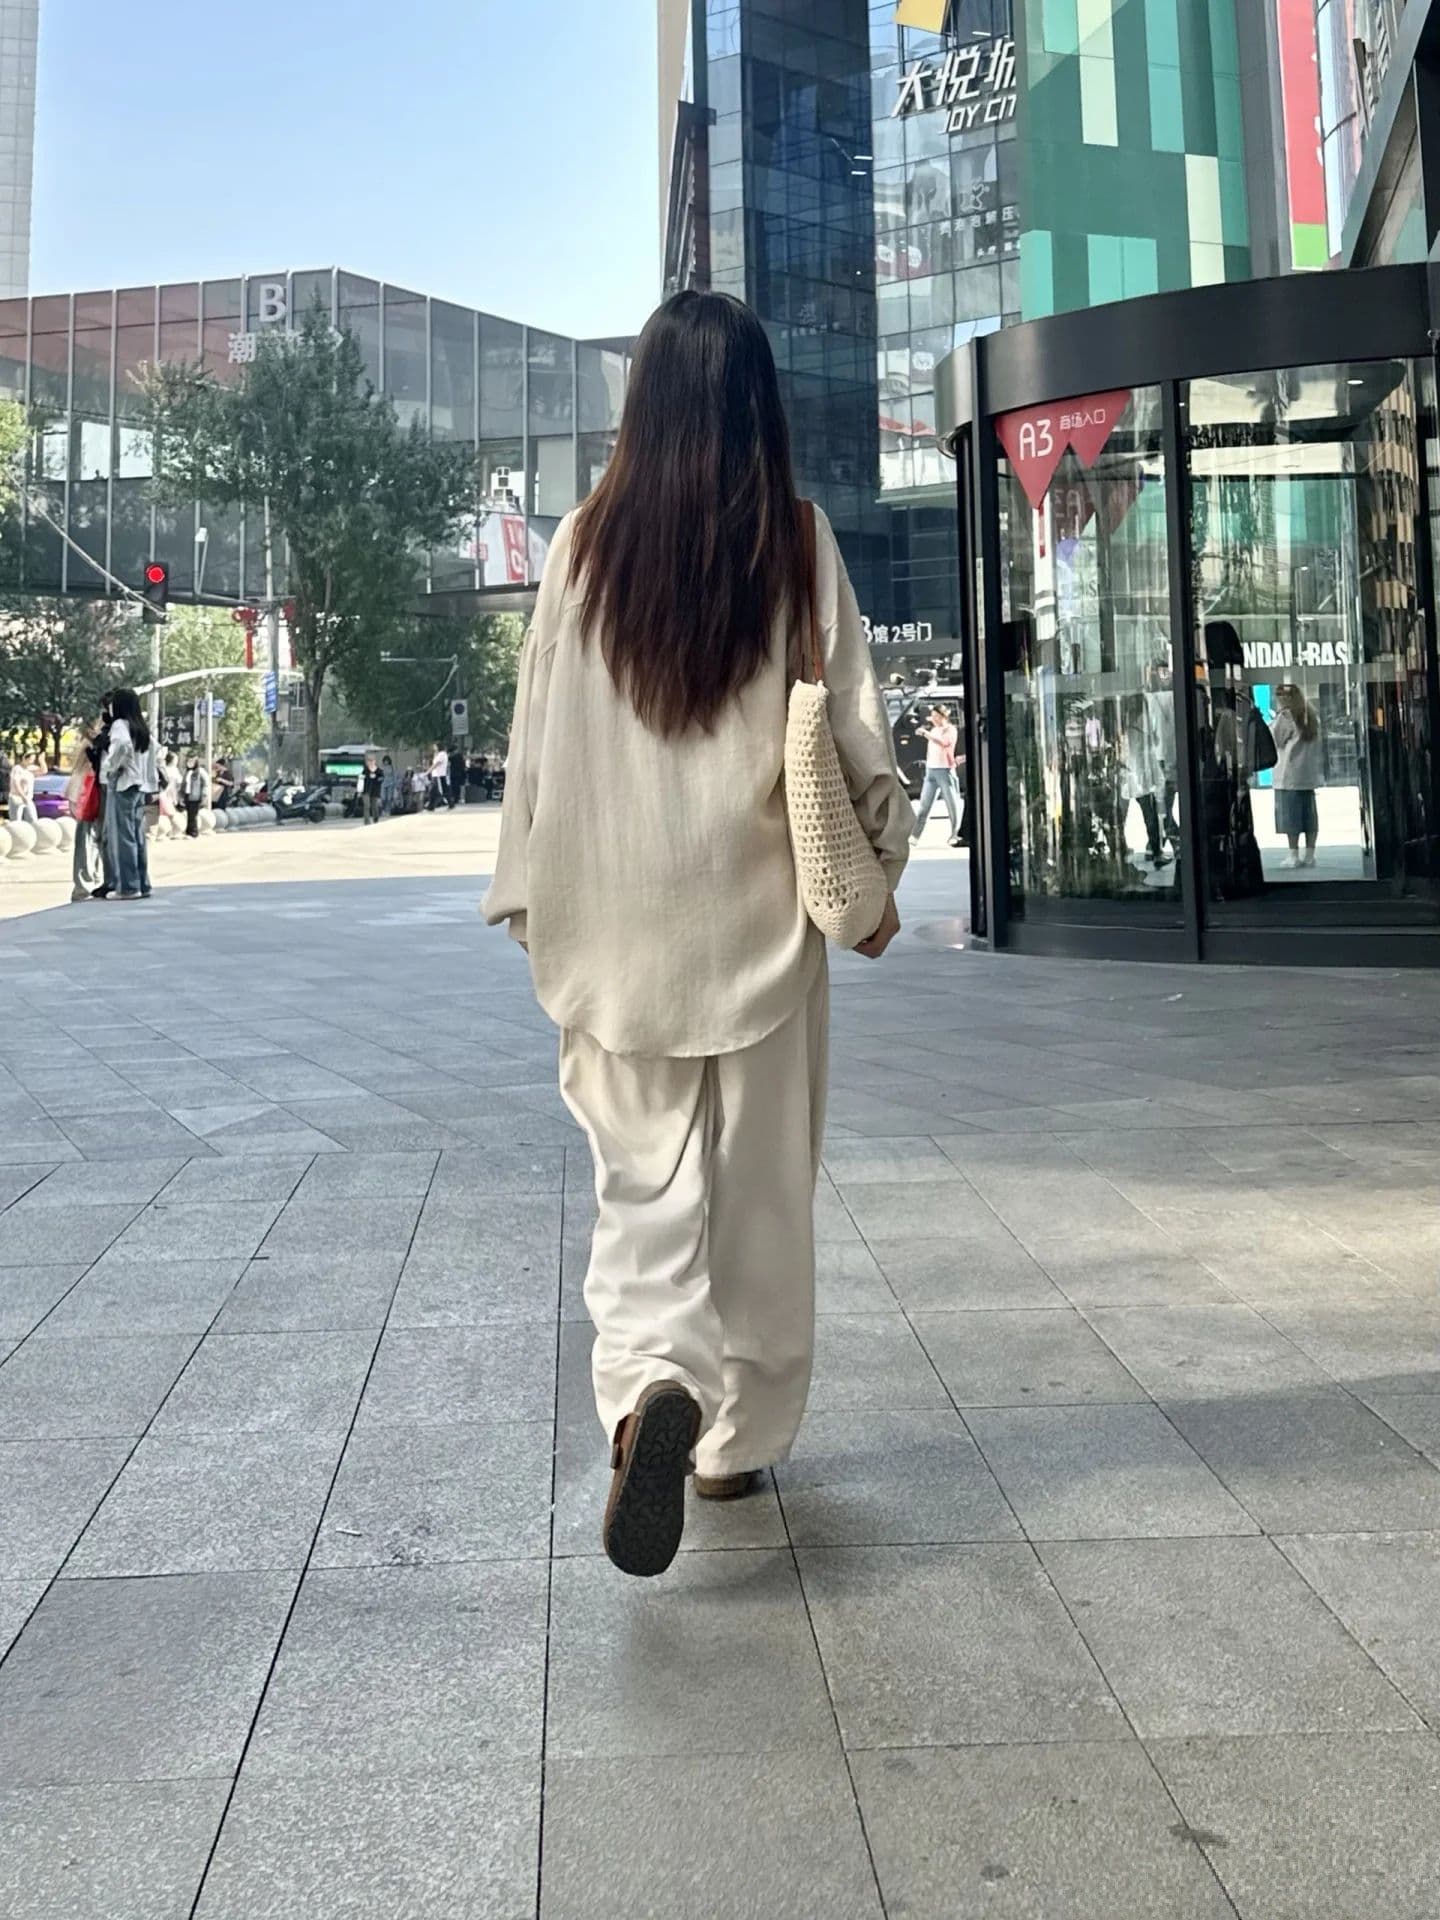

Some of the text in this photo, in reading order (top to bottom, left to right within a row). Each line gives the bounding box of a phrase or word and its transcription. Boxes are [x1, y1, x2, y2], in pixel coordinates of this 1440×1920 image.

[937, 103, 980, 135] JOY
[259, 283, 286, 322] B
[1019, 418, 1053, 461] A3
